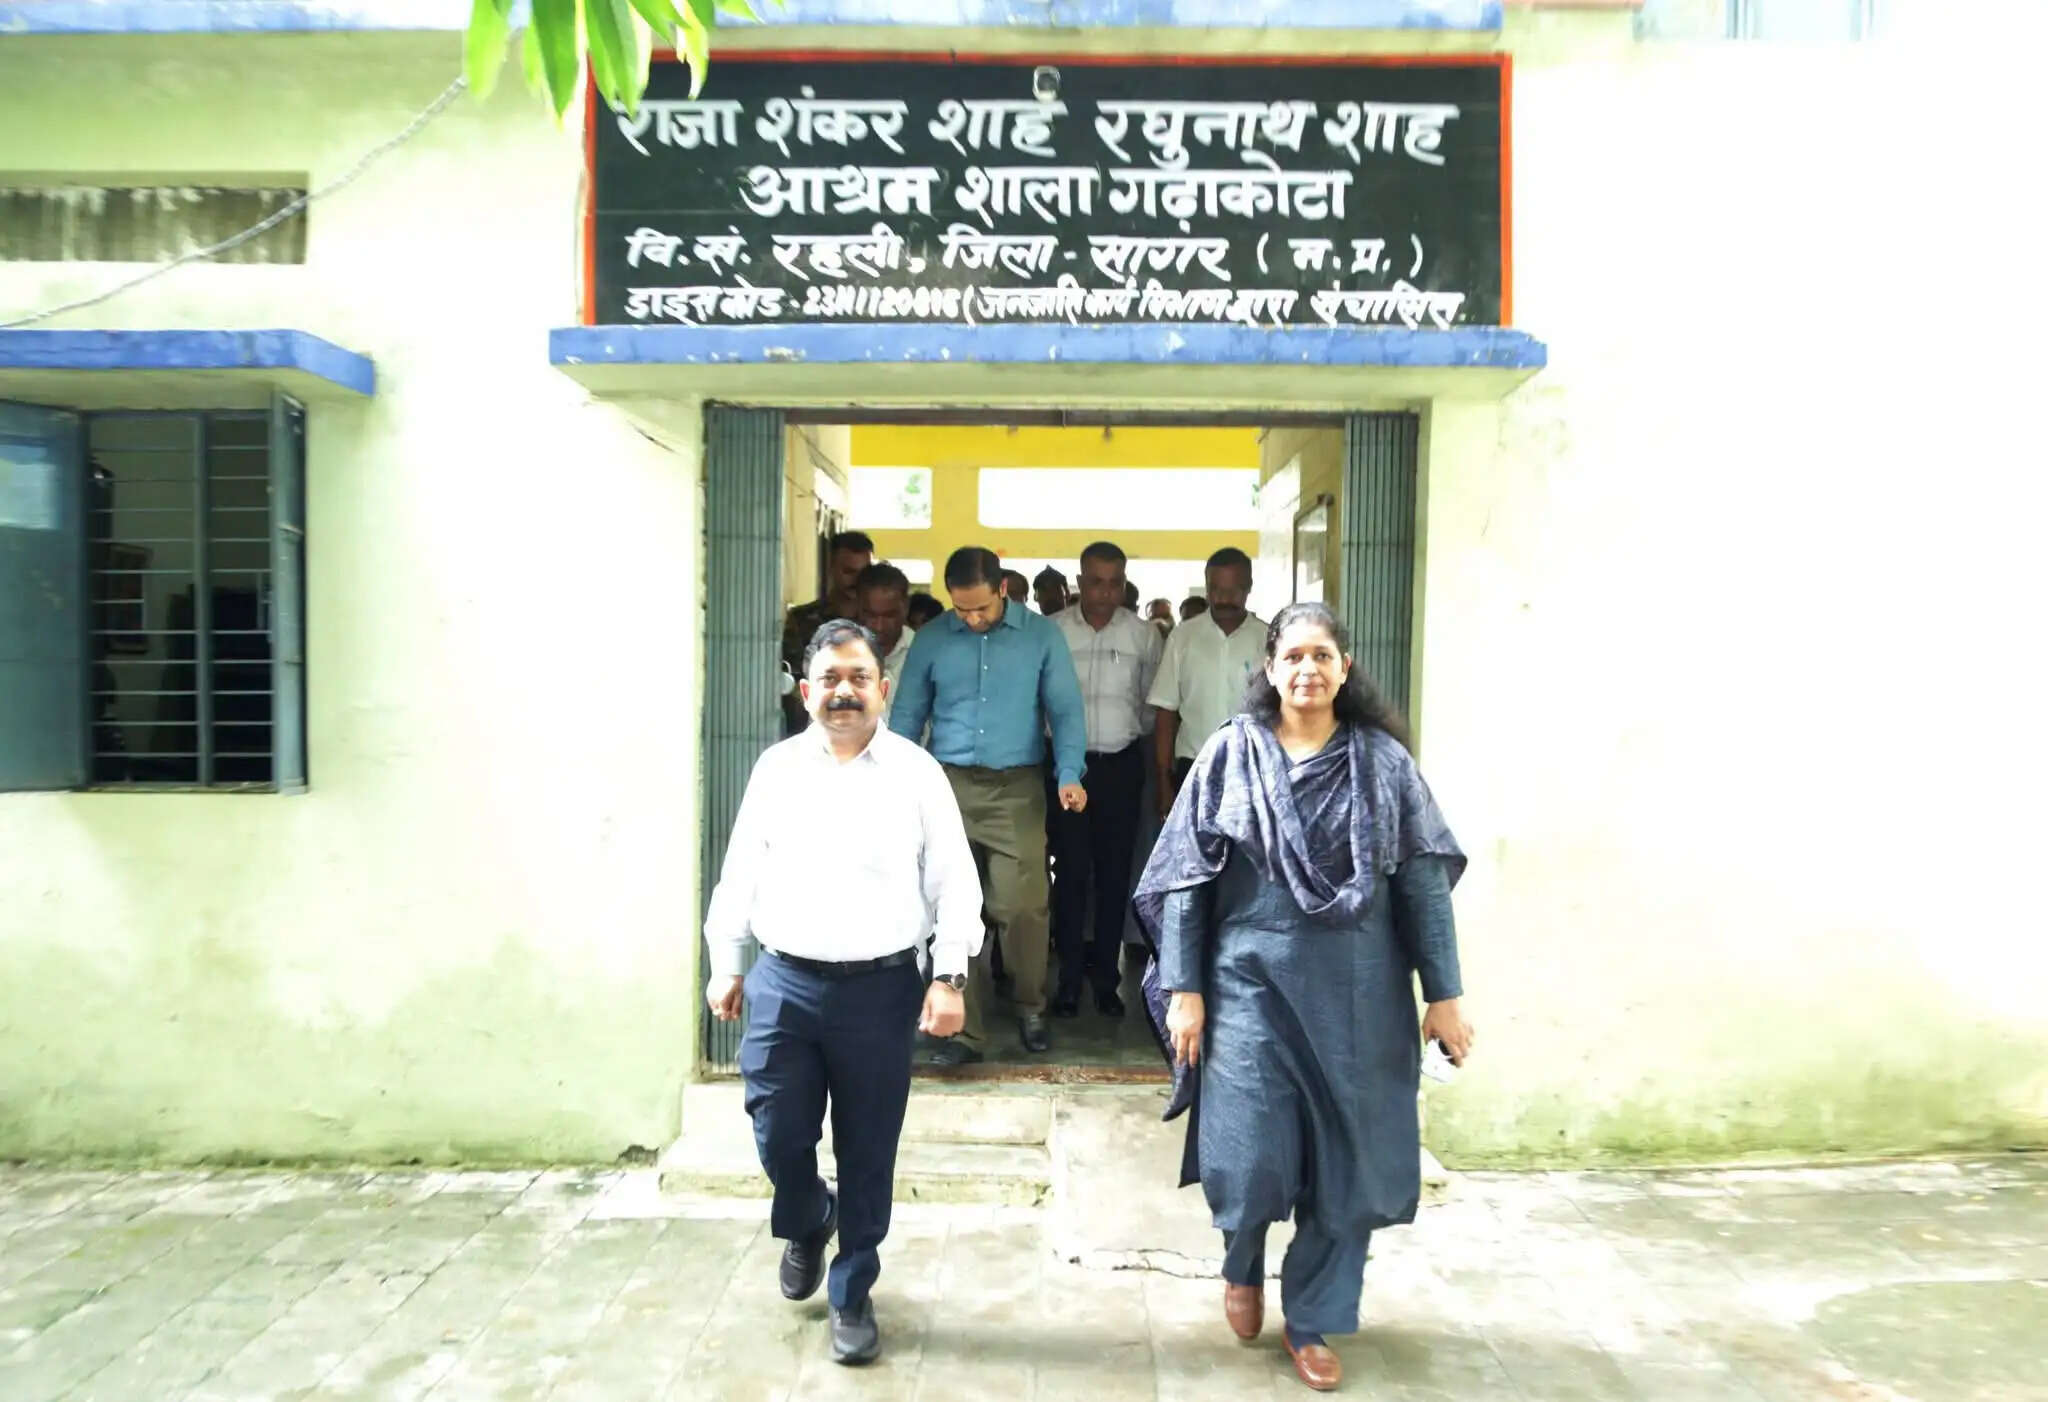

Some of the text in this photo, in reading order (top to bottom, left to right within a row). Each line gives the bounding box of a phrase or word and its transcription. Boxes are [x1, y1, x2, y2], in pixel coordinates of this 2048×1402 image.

[614, 86, 1460, 170] राजा शंकर शाह रघुनाथ शाह
[738, 165, 940, 217] आश्रम
[955, 165, 1099, 229] शाला
[1087, 235, 1232, 284] सागर
